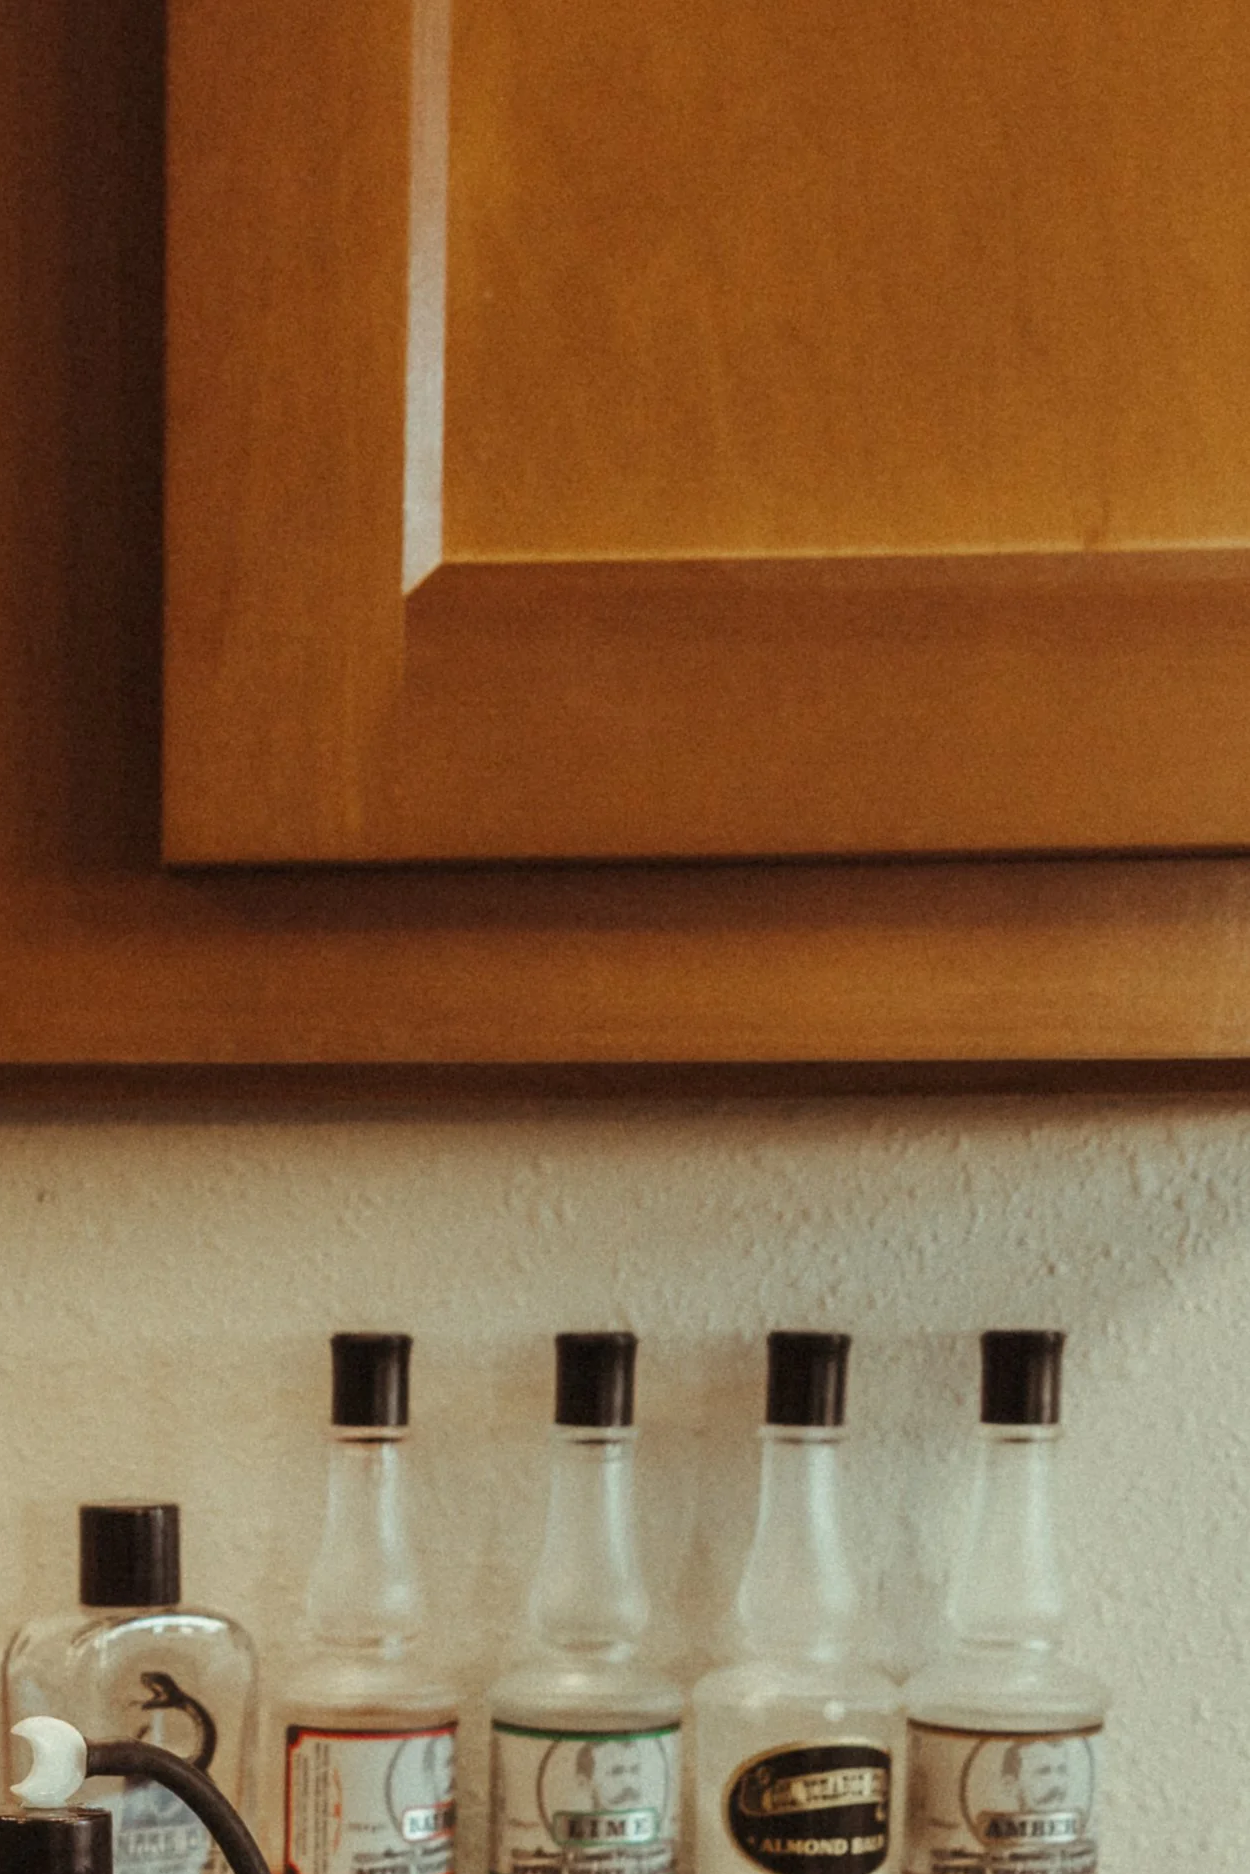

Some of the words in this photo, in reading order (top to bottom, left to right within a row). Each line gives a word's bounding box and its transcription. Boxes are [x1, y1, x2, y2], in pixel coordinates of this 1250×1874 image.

[568, 1819, 649, 1839] LIME
[985, 1819, 1078, 1839] AMBER
[761, 1838, 849, 1857] ALMOND
